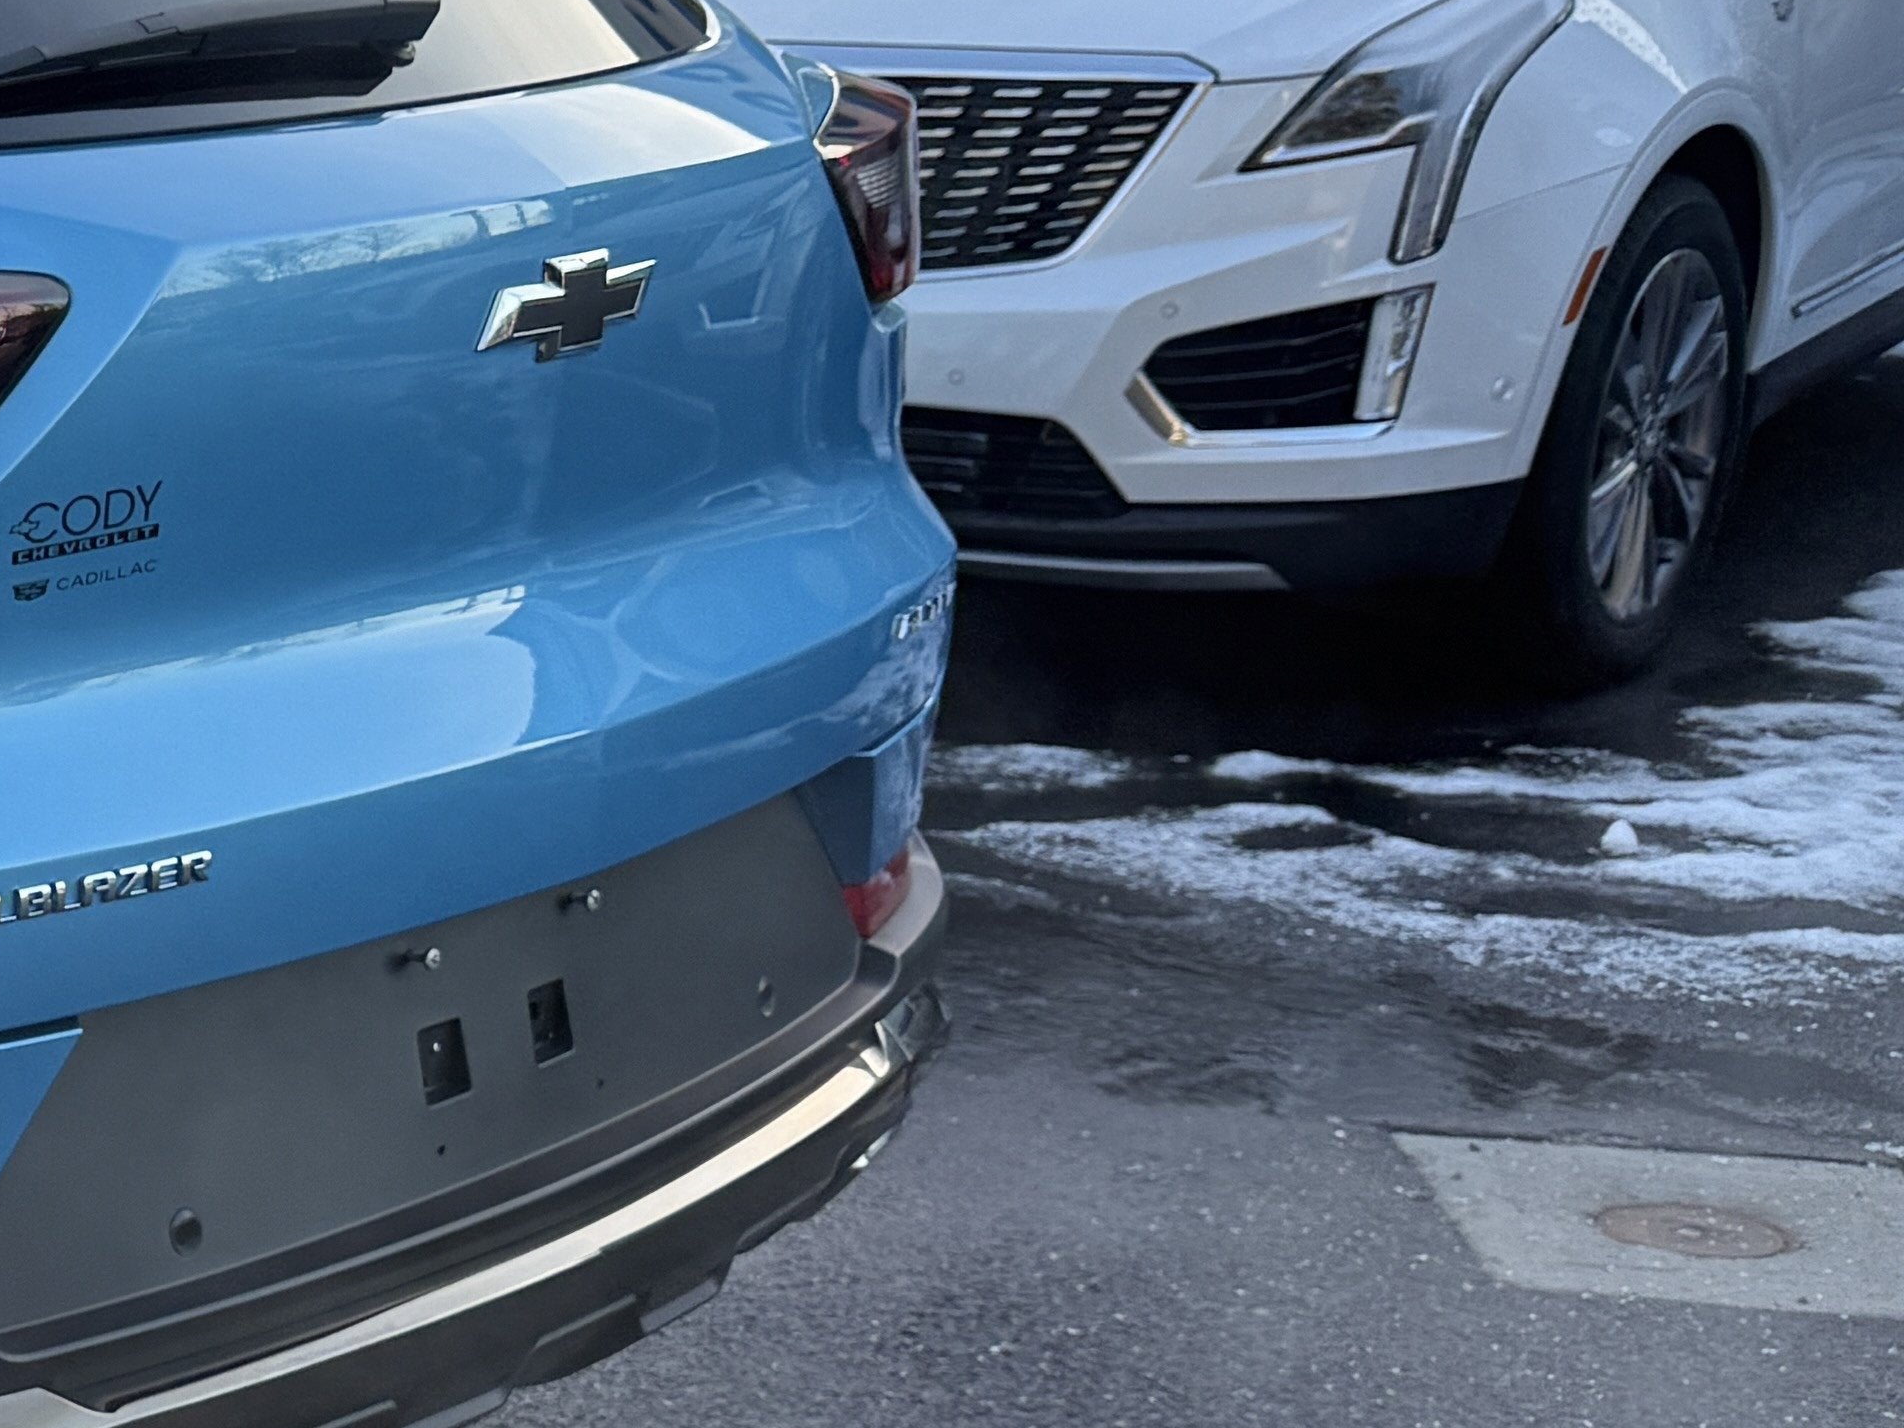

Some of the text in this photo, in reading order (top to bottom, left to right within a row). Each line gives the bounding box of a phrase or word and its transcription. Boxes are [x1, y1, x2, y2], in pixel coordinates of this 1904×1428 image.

[10, 480, 163, 543] CODY
[17, 525, 156, 563] CHEVROLET
[56, 559, 157, 590] CADILLAC
